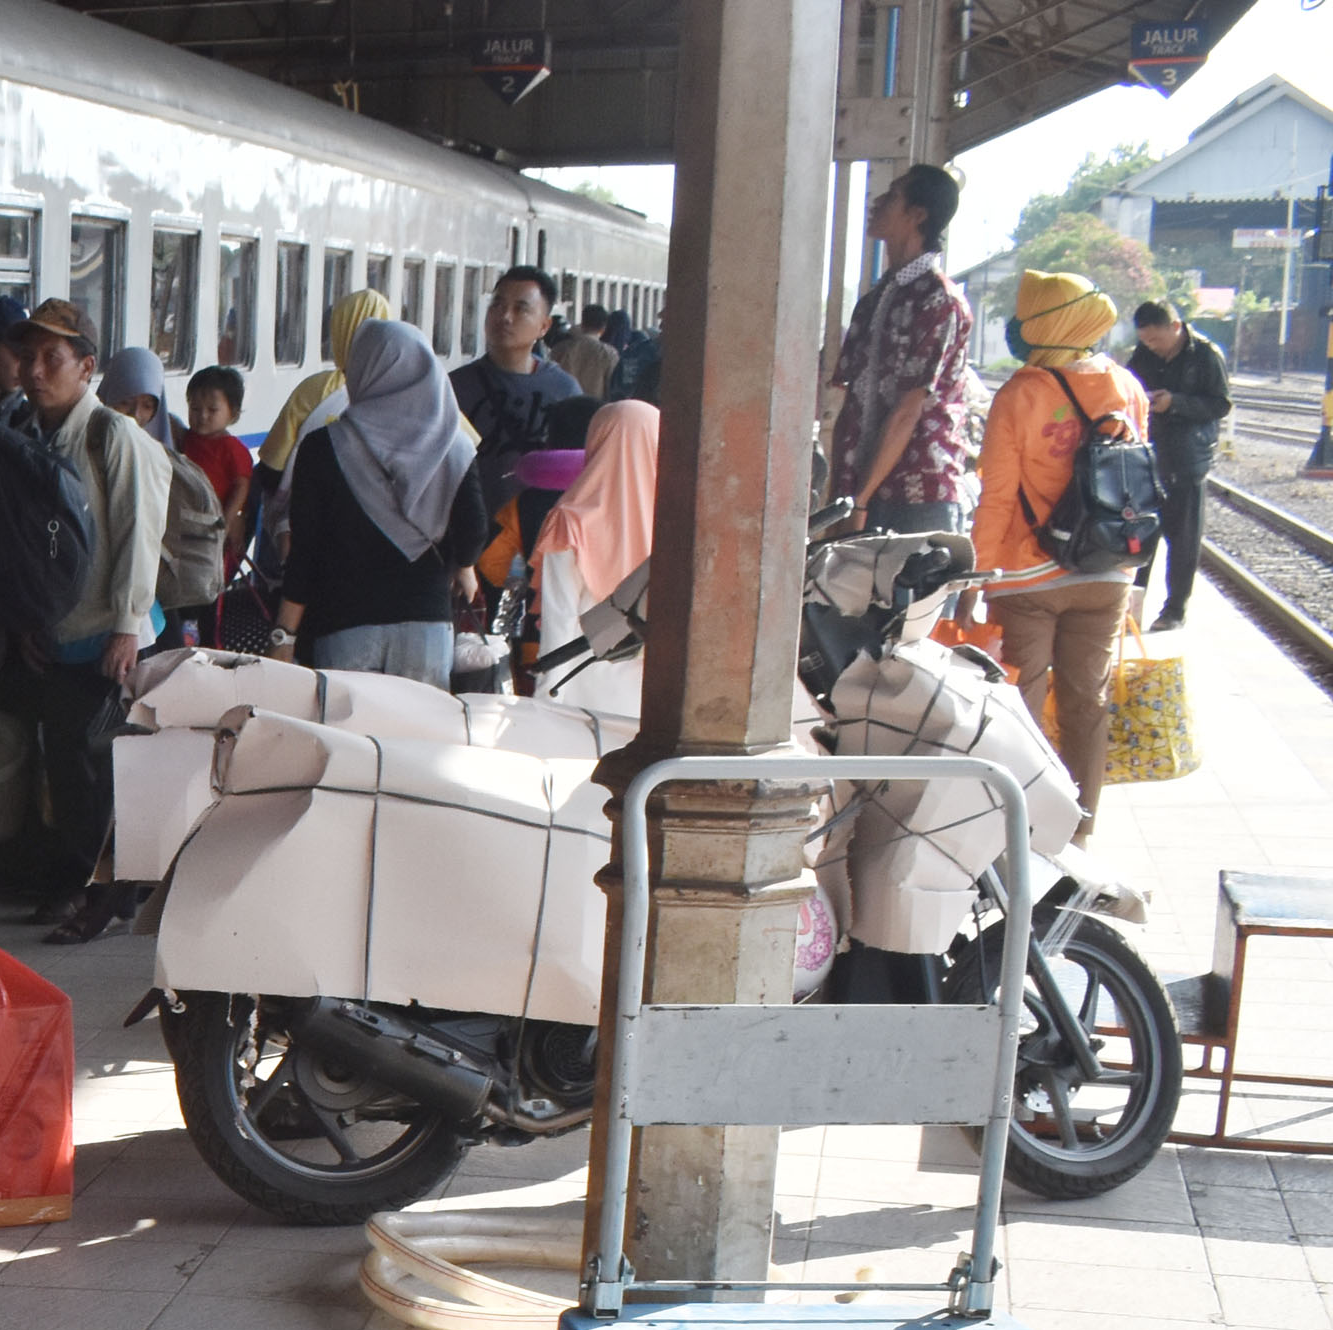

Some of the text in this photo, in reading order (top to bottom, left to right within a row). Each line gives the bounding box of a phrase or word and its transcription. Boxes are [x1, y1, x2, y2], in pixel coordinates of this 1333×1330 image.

[1141, 28, 1199, 46] JALUR
[483, 38, 534, 56] JALUR
[501, 76, 515, 93] 2
[1162, 68, 1177, 86] 3
